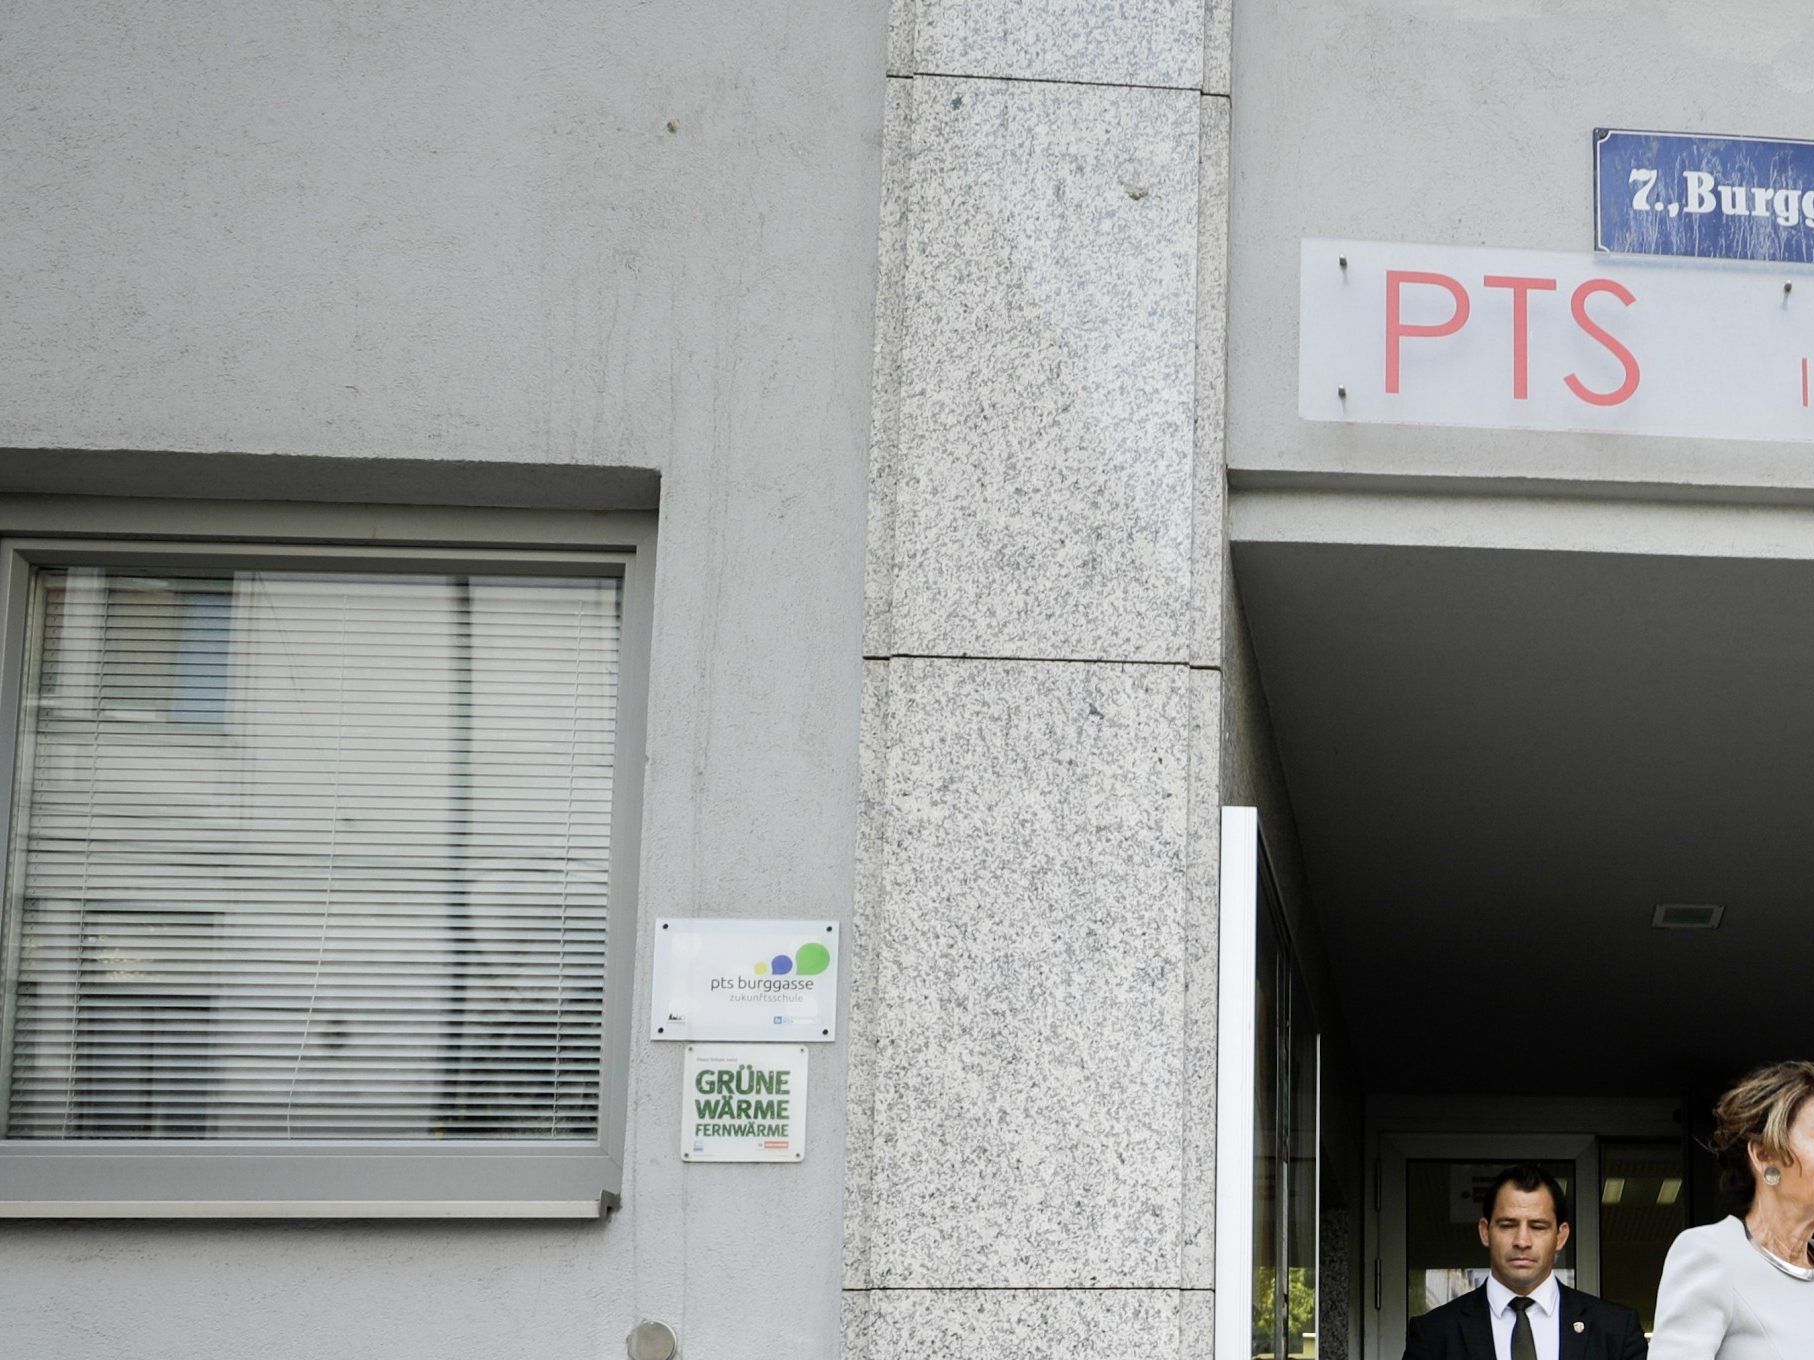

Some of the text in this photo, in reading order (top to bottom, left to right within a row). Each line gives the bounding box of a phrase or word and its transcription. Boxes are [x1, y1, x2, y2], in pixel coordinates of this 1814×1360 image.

[1385, 270, 1642, 406] PTS
[710, 976, 814, 992] pts burggasse
[729, 992, 803, 1003] zukunftsschule
[695, 1064, 791, 1095] GRÜNE
[695, 1095, 790, 1120] WÄRME
[695, 1122, 789, 1137] FERNWÄRME
